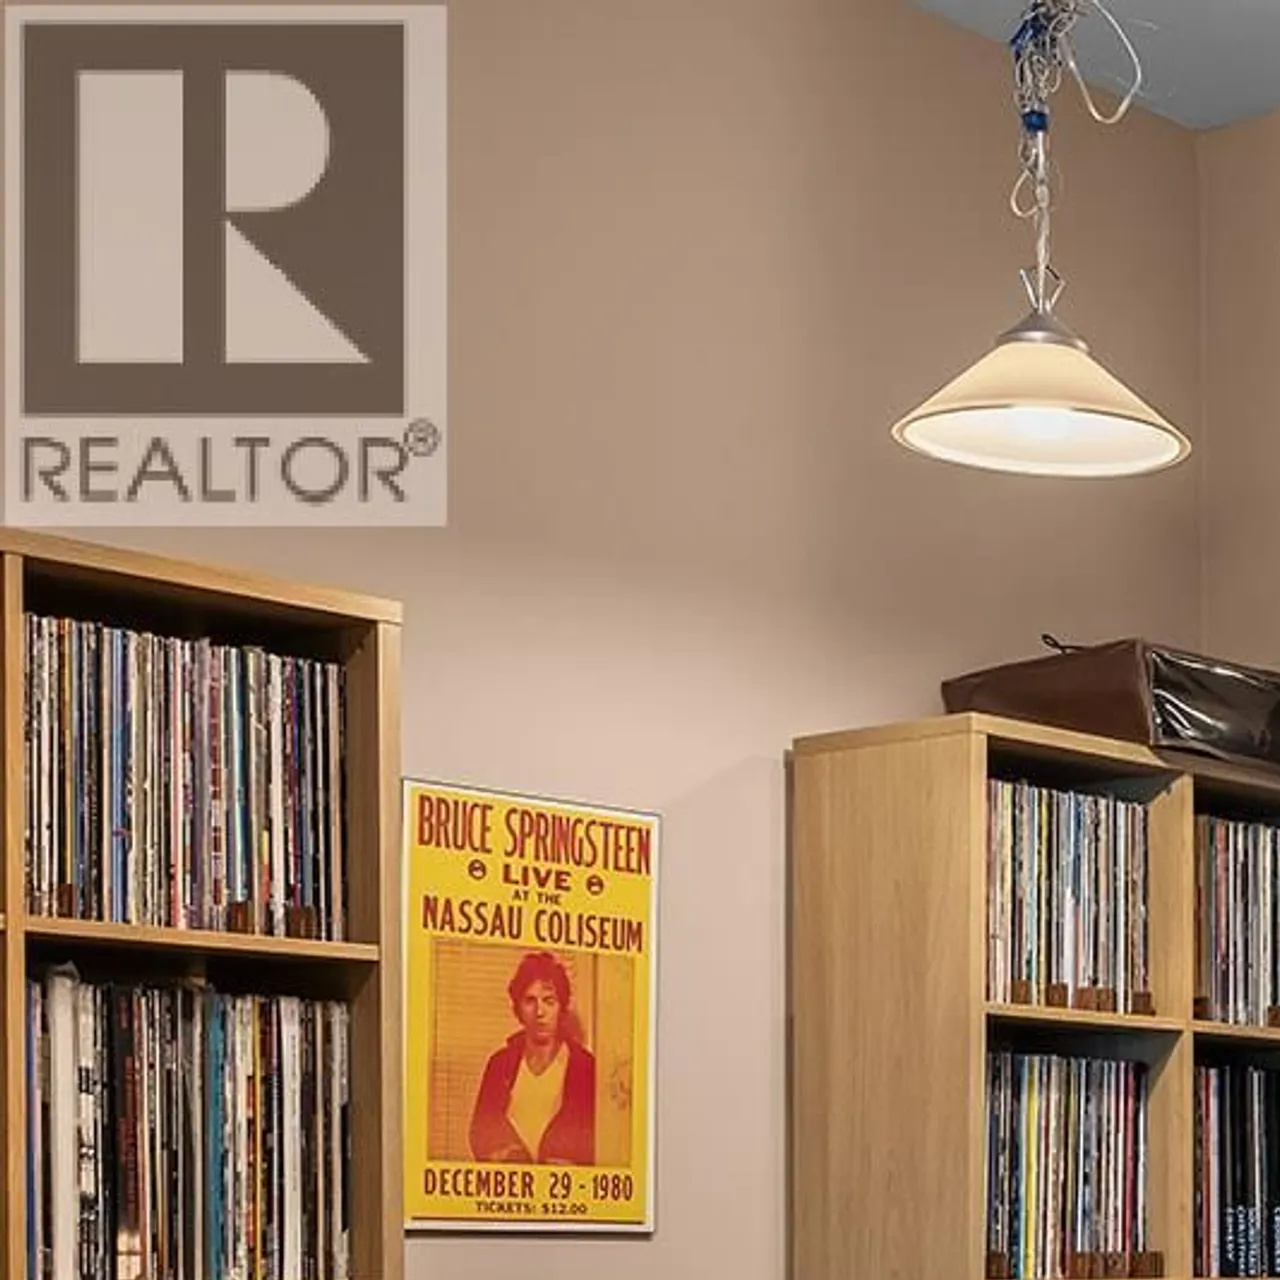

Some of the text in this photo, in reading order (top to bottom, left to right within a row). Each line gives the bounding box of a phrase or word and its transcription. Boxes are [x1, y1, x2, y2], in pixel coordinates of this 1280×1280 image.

[418, 794, 651, 876] BRUCE SPRINGSTEEN
[502, 863, 572, 892] LIVE
[512, 890, 562, 906] AT THE
[422, 895, 643, 954] NASSAU COLISEUM
[424, 1168, 535, 1199] DECEMBER
[549, 1171, 572, 1199] 29
[592, 1174, 634, 1201] 1980
